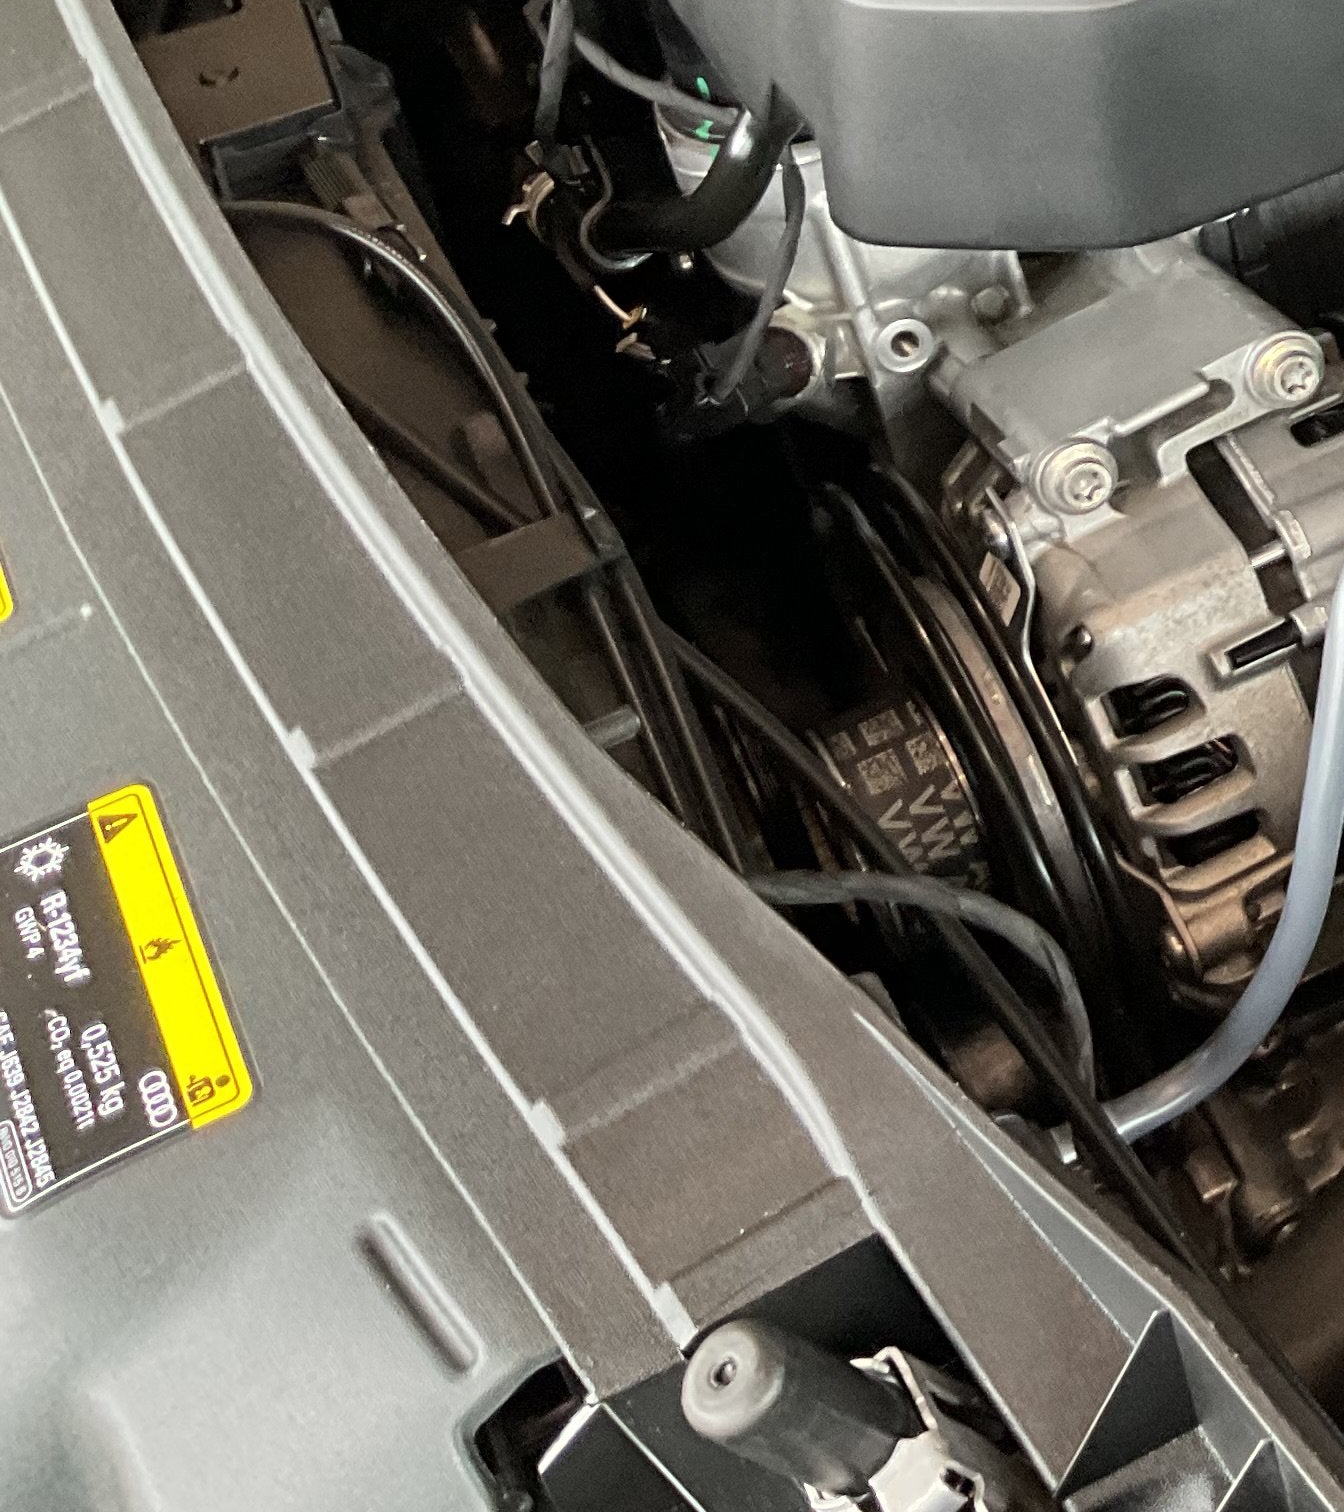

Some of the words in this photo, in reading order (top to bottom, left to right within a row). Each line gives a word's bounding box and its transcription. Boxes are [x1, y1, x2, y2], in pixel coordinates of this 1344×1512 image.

[15, 907, 41, 943] GWP
[40, 891, 90, 982] R-1234yf
[25, 943, 45, 960] 4
[0, 1050, 25, 1088] J639
[55, 1049, 74, 1073] eq
[81, 1022, 120, 1084] 0,525
[9, 1089, 39, 1137] J2842
[97, 1081, 125, 1118] kg
[24, 1138, 59, 1188] J2845
